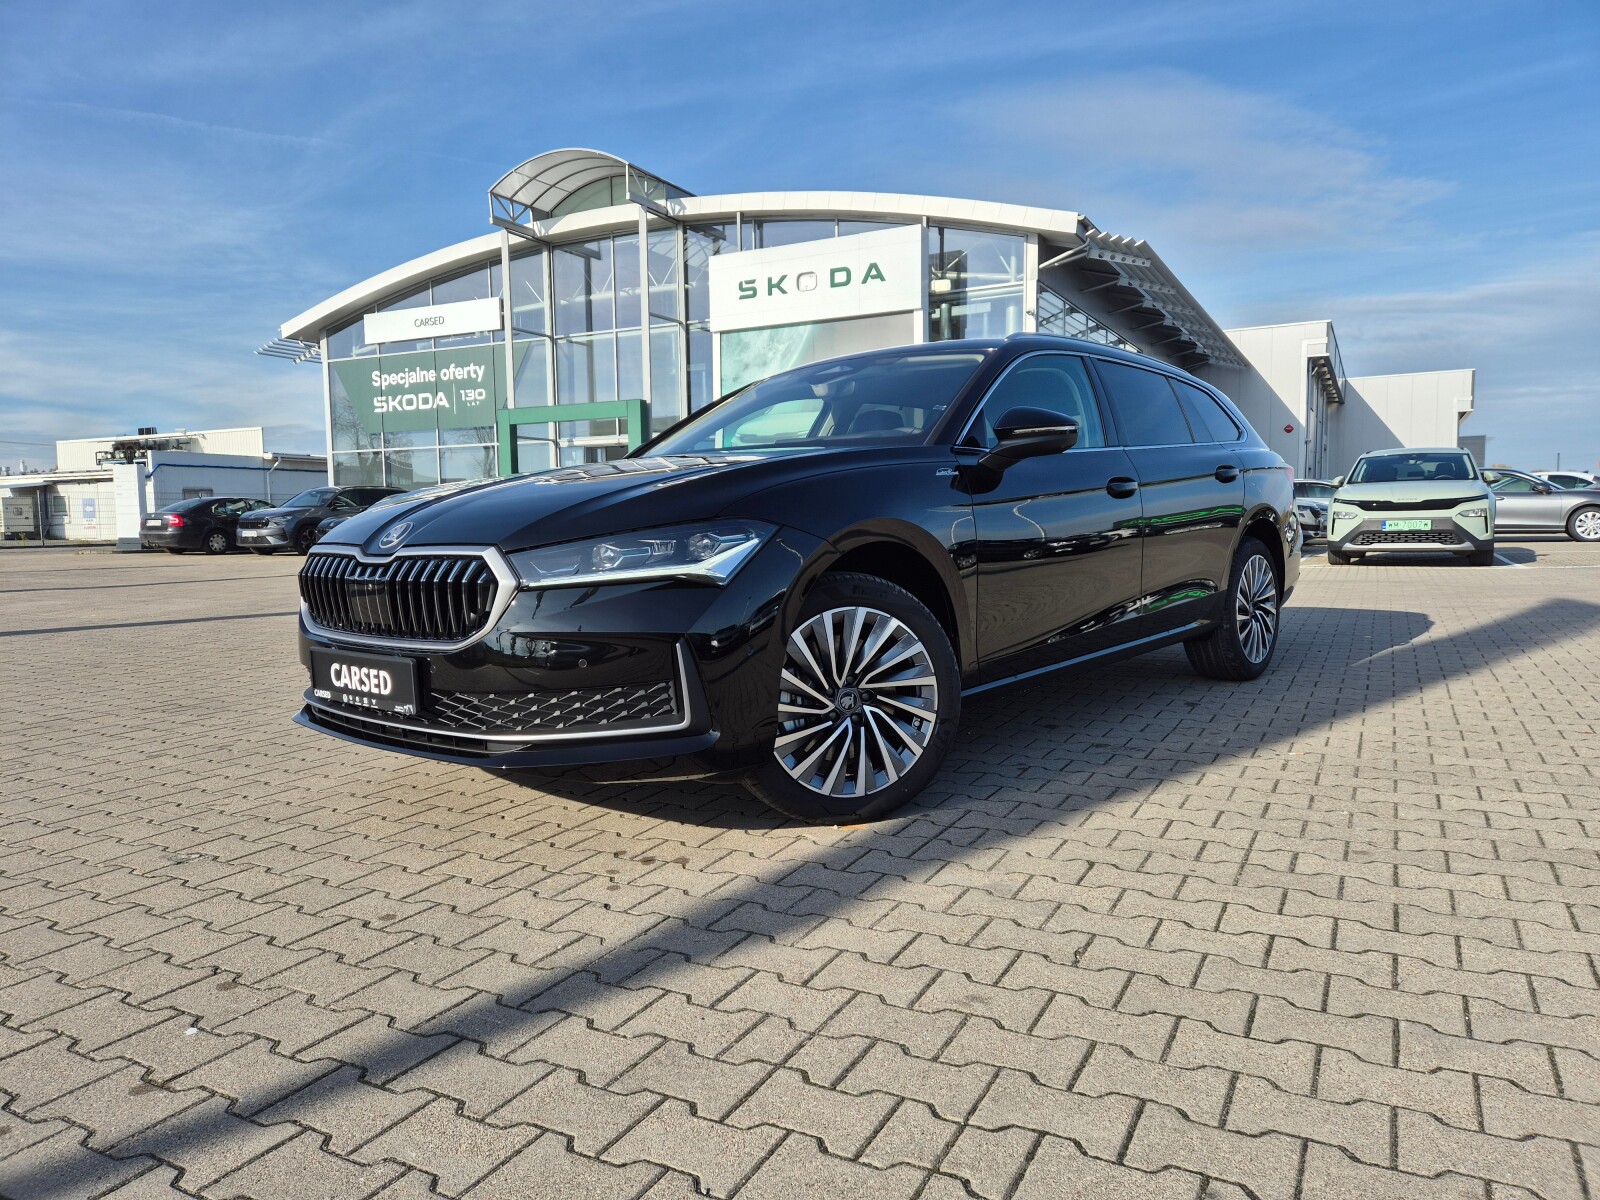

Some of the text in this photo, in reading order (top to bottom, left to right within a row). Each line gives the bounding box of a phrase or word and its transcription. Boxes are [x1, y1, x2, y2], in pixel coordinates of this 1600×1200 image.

[414, 315, 445, 328] CARSED
[371, 362, 485, 390] Specjalne oferty
[459, 388, 486, 401] 130
[330, 662, 392, 695] CARSED
[314, 688, 331, 699] CARSED
